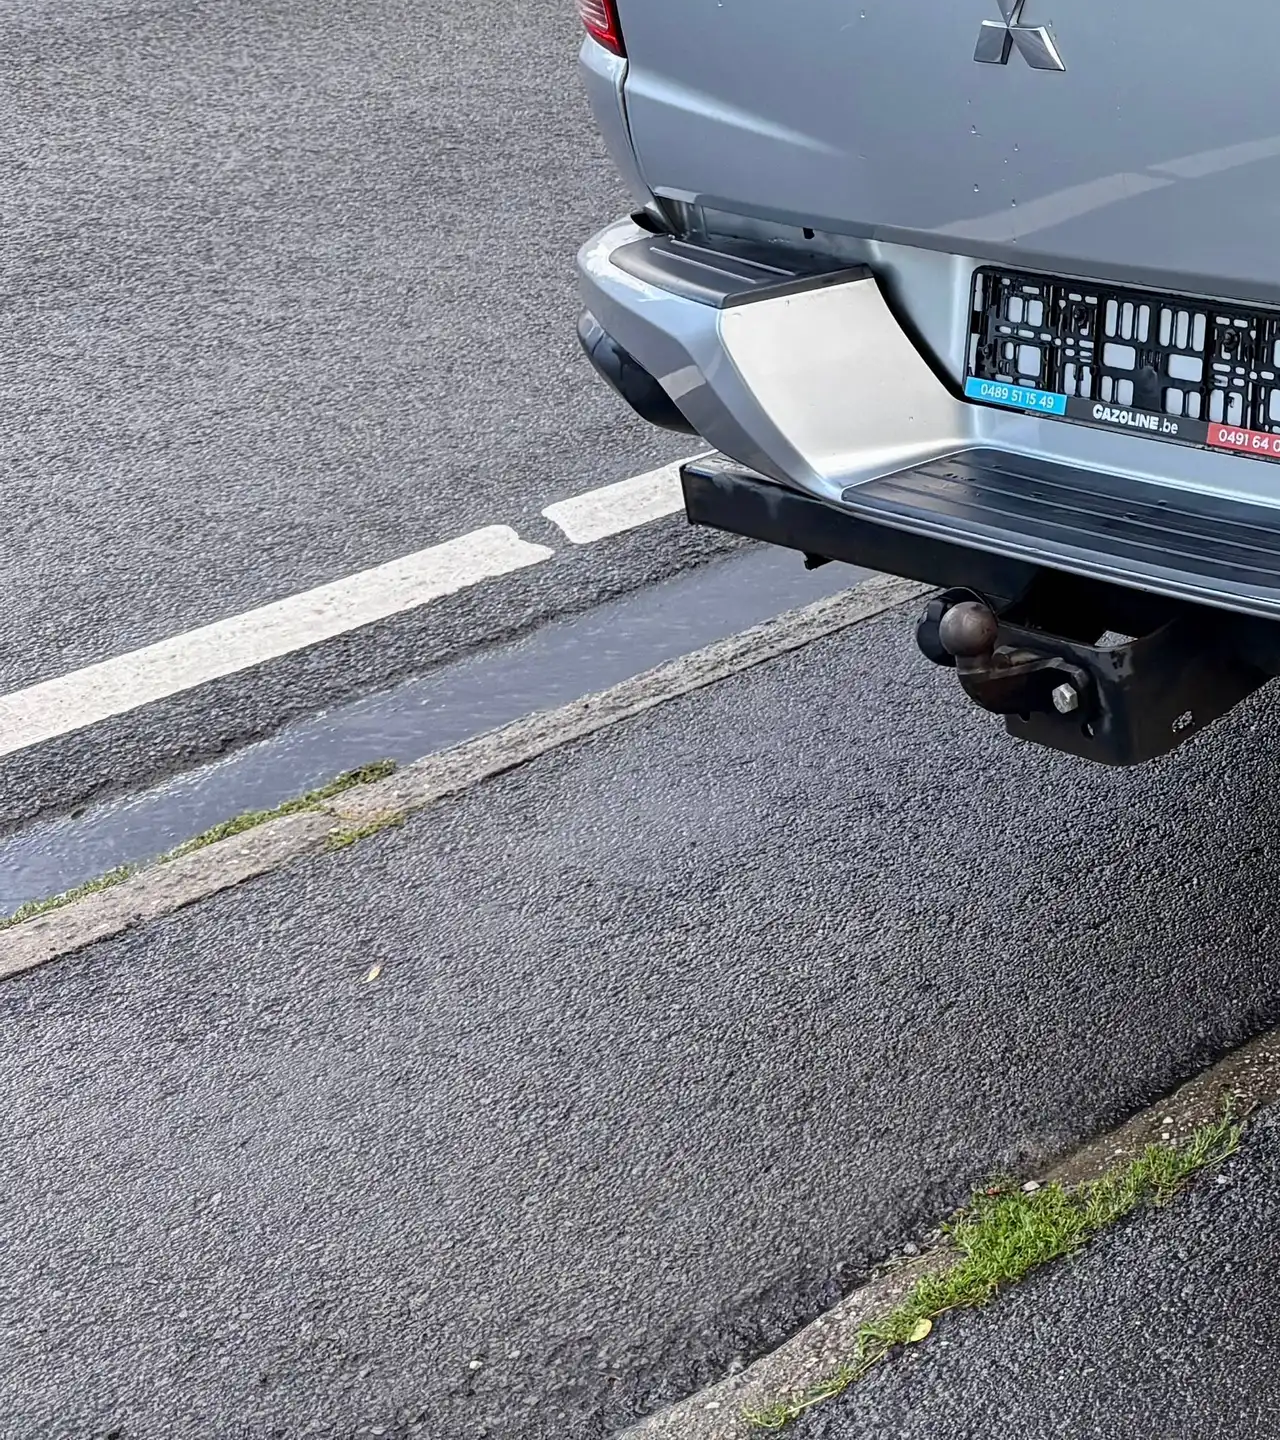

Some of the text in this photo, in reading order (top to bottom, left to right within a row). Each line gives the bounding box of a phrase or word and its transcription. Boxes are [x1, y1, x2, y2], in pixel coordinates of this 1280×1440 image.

[981, 384, 1054, 409] 0489 51 15 49
[1092, 404, 1179, 434] GAZOLINE.be
[1218, 429, 1249, 447] 0491
[1252, 434, 1269, 450] 64
